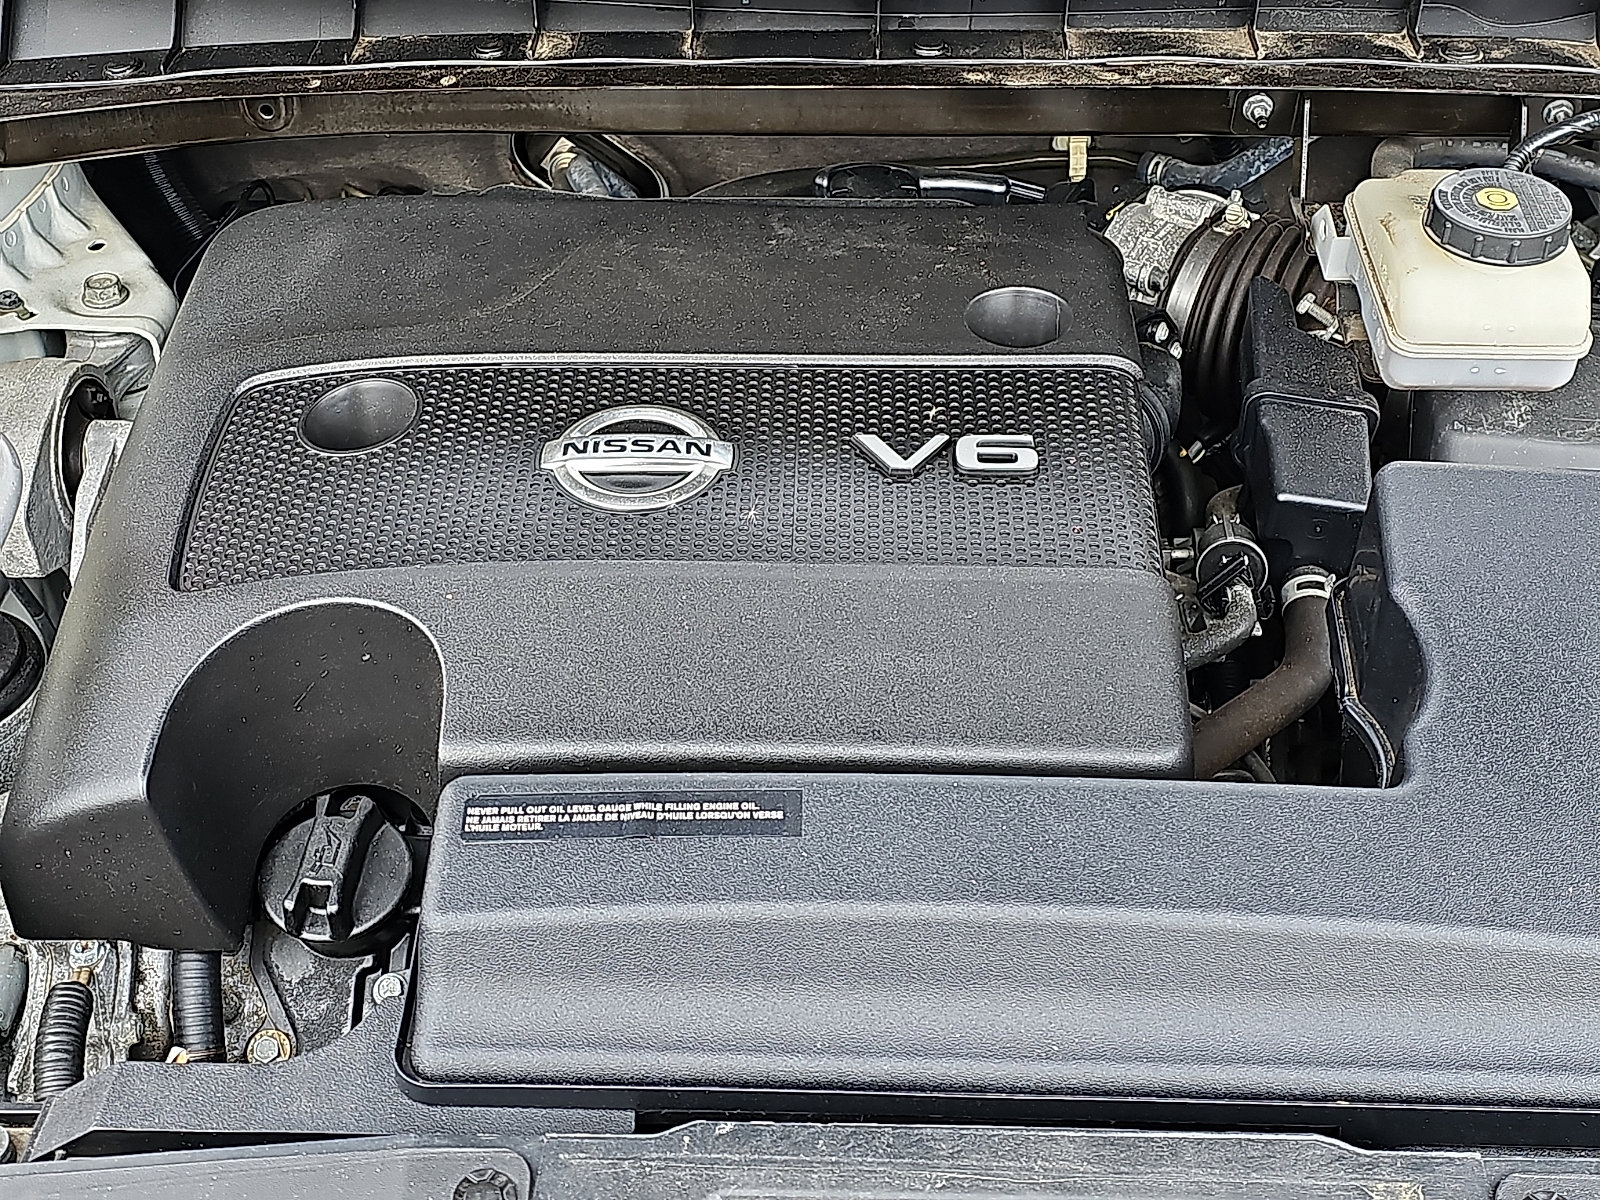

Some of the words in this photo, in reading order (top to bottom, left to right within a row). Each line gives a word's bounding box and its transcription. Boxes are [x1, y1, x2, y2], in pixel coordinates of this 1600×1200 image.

[562, 439, 712, 457] NISSAN
[850, 434, 1039, 476] V6
[467, 806, 499, 815] NEVER
[501, 805, 524, 815] PULL
[526, 805, 548, 814] OUT
[549, 805, 565, 813] OIL
[567, 804, 596, 813] LEVEL
[598, 803, 632, 812] GAUGE
[633, 803, 663, 811] WHILE
[665, 803, 701, 811] FILLING
[703, 802, 739, 811] ENGINE
[741, 802, 760, 811] OIL.
[466, 815, 480, 824] NE
[481, 815, 515, 824] JAMAIS
[517, 814, 556, 823] RETIRER
[558, 813, 571, 822] LA
[572, 813, 602, 822] JAUGE
[604, 812, 619, 821] DE
[620, 811, 655, 821] NIVEAU
[656, 811, 694, 821] D'HUILE
[695, 811, 751, 820] LORSQU'ON
[752, 810, 784, 820] VERSE
[464, 824, 500, 833] L'HUILE
[501, 823, 544, 832] MOTEUR.
